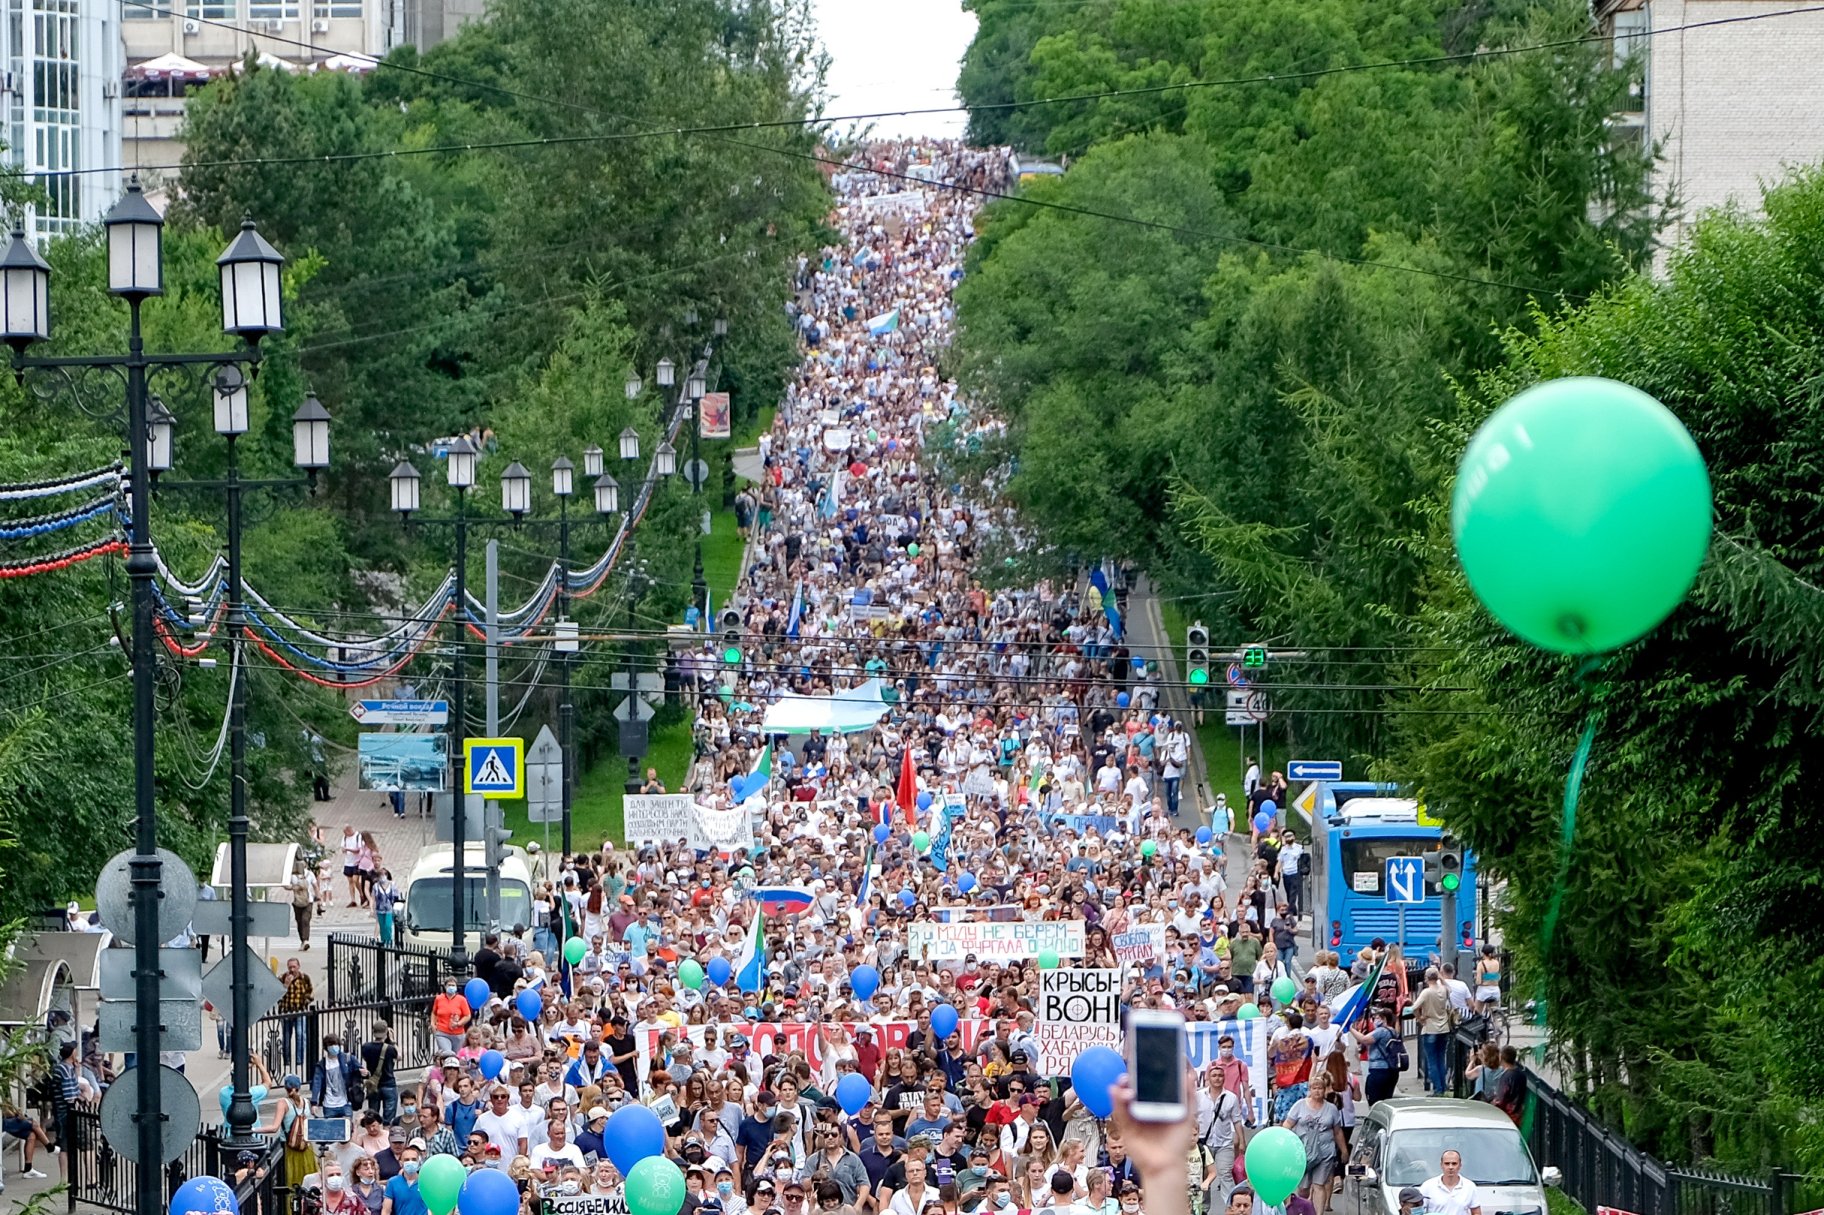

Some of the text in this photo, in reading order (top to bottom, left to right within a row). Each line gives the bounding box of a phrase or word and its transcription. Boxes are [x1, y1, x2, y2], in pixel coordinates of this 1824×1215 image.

[983, 924, 1005, 940] НЕ
[962, 940, 1024, 955] ФУРГАЛА
[1115, 944, 1154, 961] ФУРГАЛУ
[1043, 972, 1119, 993] КРЫСЫ-
[1046, 993, 1121, 1024] ВОН!
[1041, 1024, 1116, 1042] БЕЛАРУСЬ
